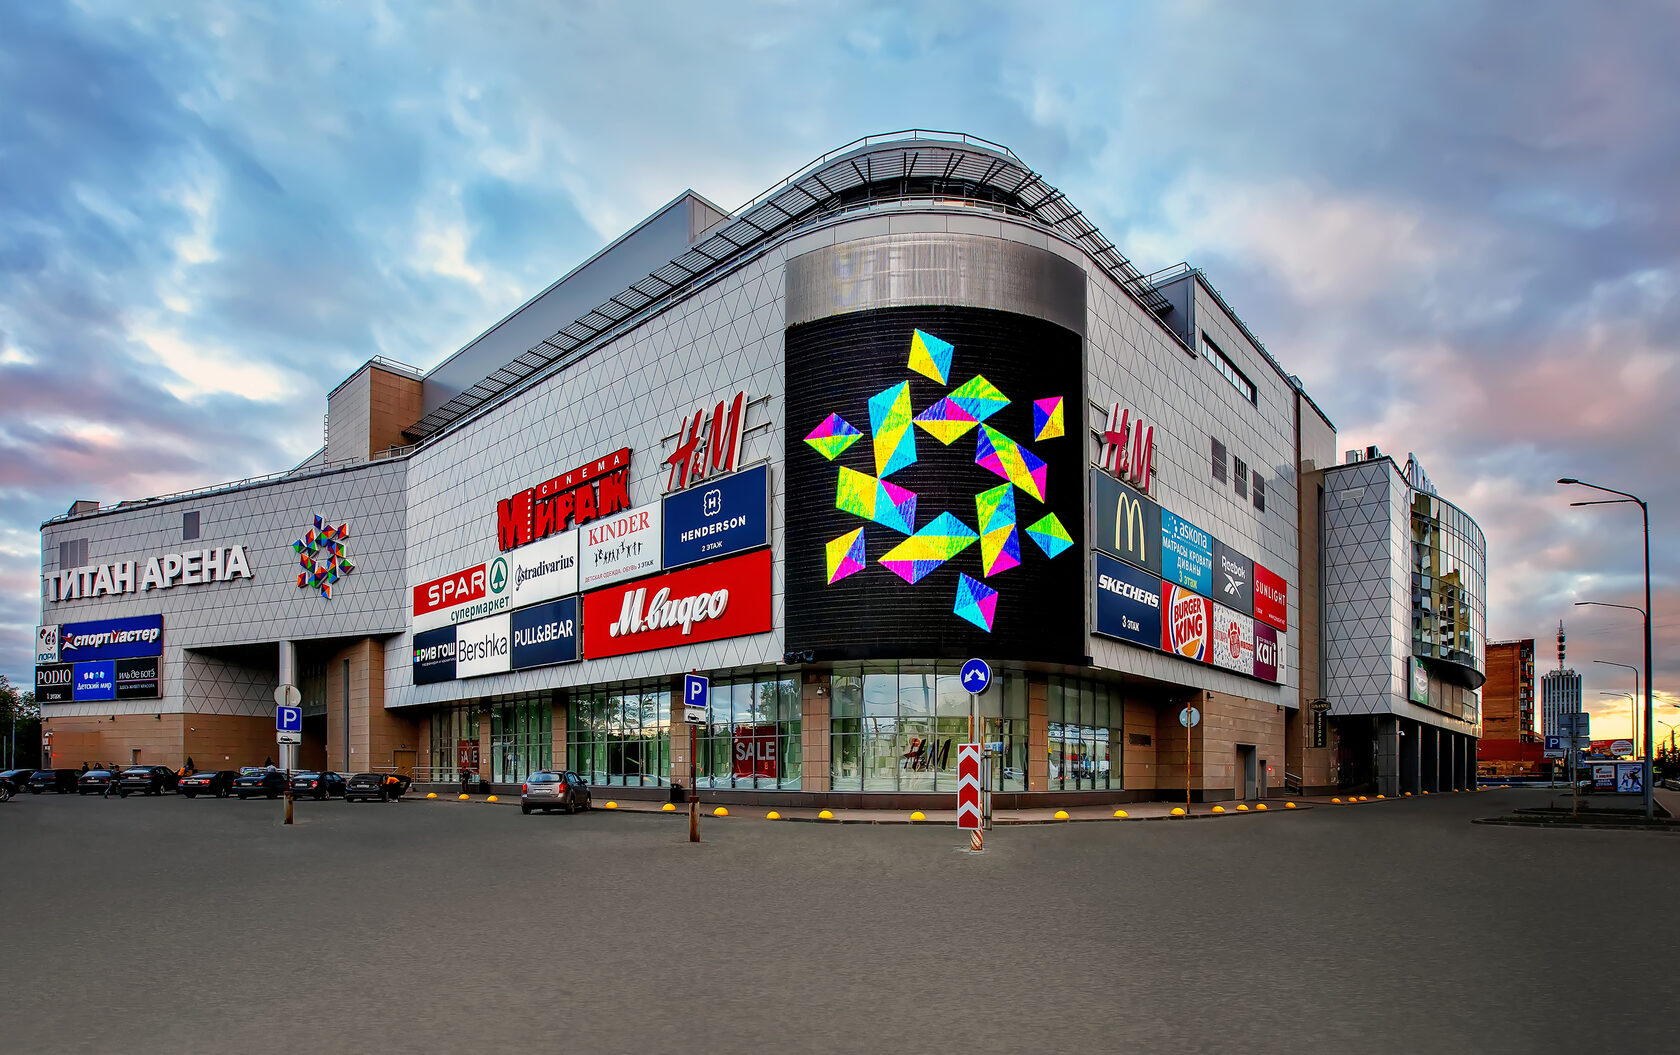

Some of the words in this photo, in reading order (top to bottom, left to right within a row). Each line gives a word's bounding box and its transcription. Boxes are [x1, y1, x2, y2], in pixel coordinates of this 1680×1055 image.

[667, 391, 748, 491] H&M
[1100, 403, 1153, 495] H&M
[542, 455, 620, 494] CINEMA
[588, 511, 650, 546] KINDER
[681, 516, 746, 542] HENDERSON
[1180, 522, 1207, 548] askona
[706, 541, 723, 551] ЭТАЖ
[1162, 536, 1188, 558] МАТРАСЫ
[1189, 549, 1212, 570] КРОВАТИ
[44, 560, 136, 602] ТИТАН
[141, 545, 252, 591] АРЕНА
[1177, 556, 1202, 577] ДИВАНЫ
[1179, 570, 1183, 582] 3
[1221, 555, 1246, 579] Reebok
[428, 569, 485, 607] SPAR
[1098, 574, 1159, 608] SKECHERS
[1256, 580, 1286, 606] SUNLIGHT
[451, 596, 510, 623] супермаркет
[1122, 615, 1127, 628] 3
[1174, 598, 1202, 623] BURGER
[514, 619, 573, 647] PULL&BEAR
[1175, 614, 1203, 649] KING
[421, 646, 437, 661] РИВ
[438, 642, 456, 658] ГОШ
[459, 633, 508, 662] Bershka
[1256, 636, 1276, 667] kari
[37, 669, 71, 684] PODIO
[77, 682, 99, 691] Детский
[100, 682, 113, 691] мир
[691, 681, 702, 700] P
[283, 709, 297, 728] P
[736, 741, 775, 761] SALE
[903, 738, 952, 771] H&M
[1550, 738, 1559, 748] P
[461, 750, 478, 763] SAE
